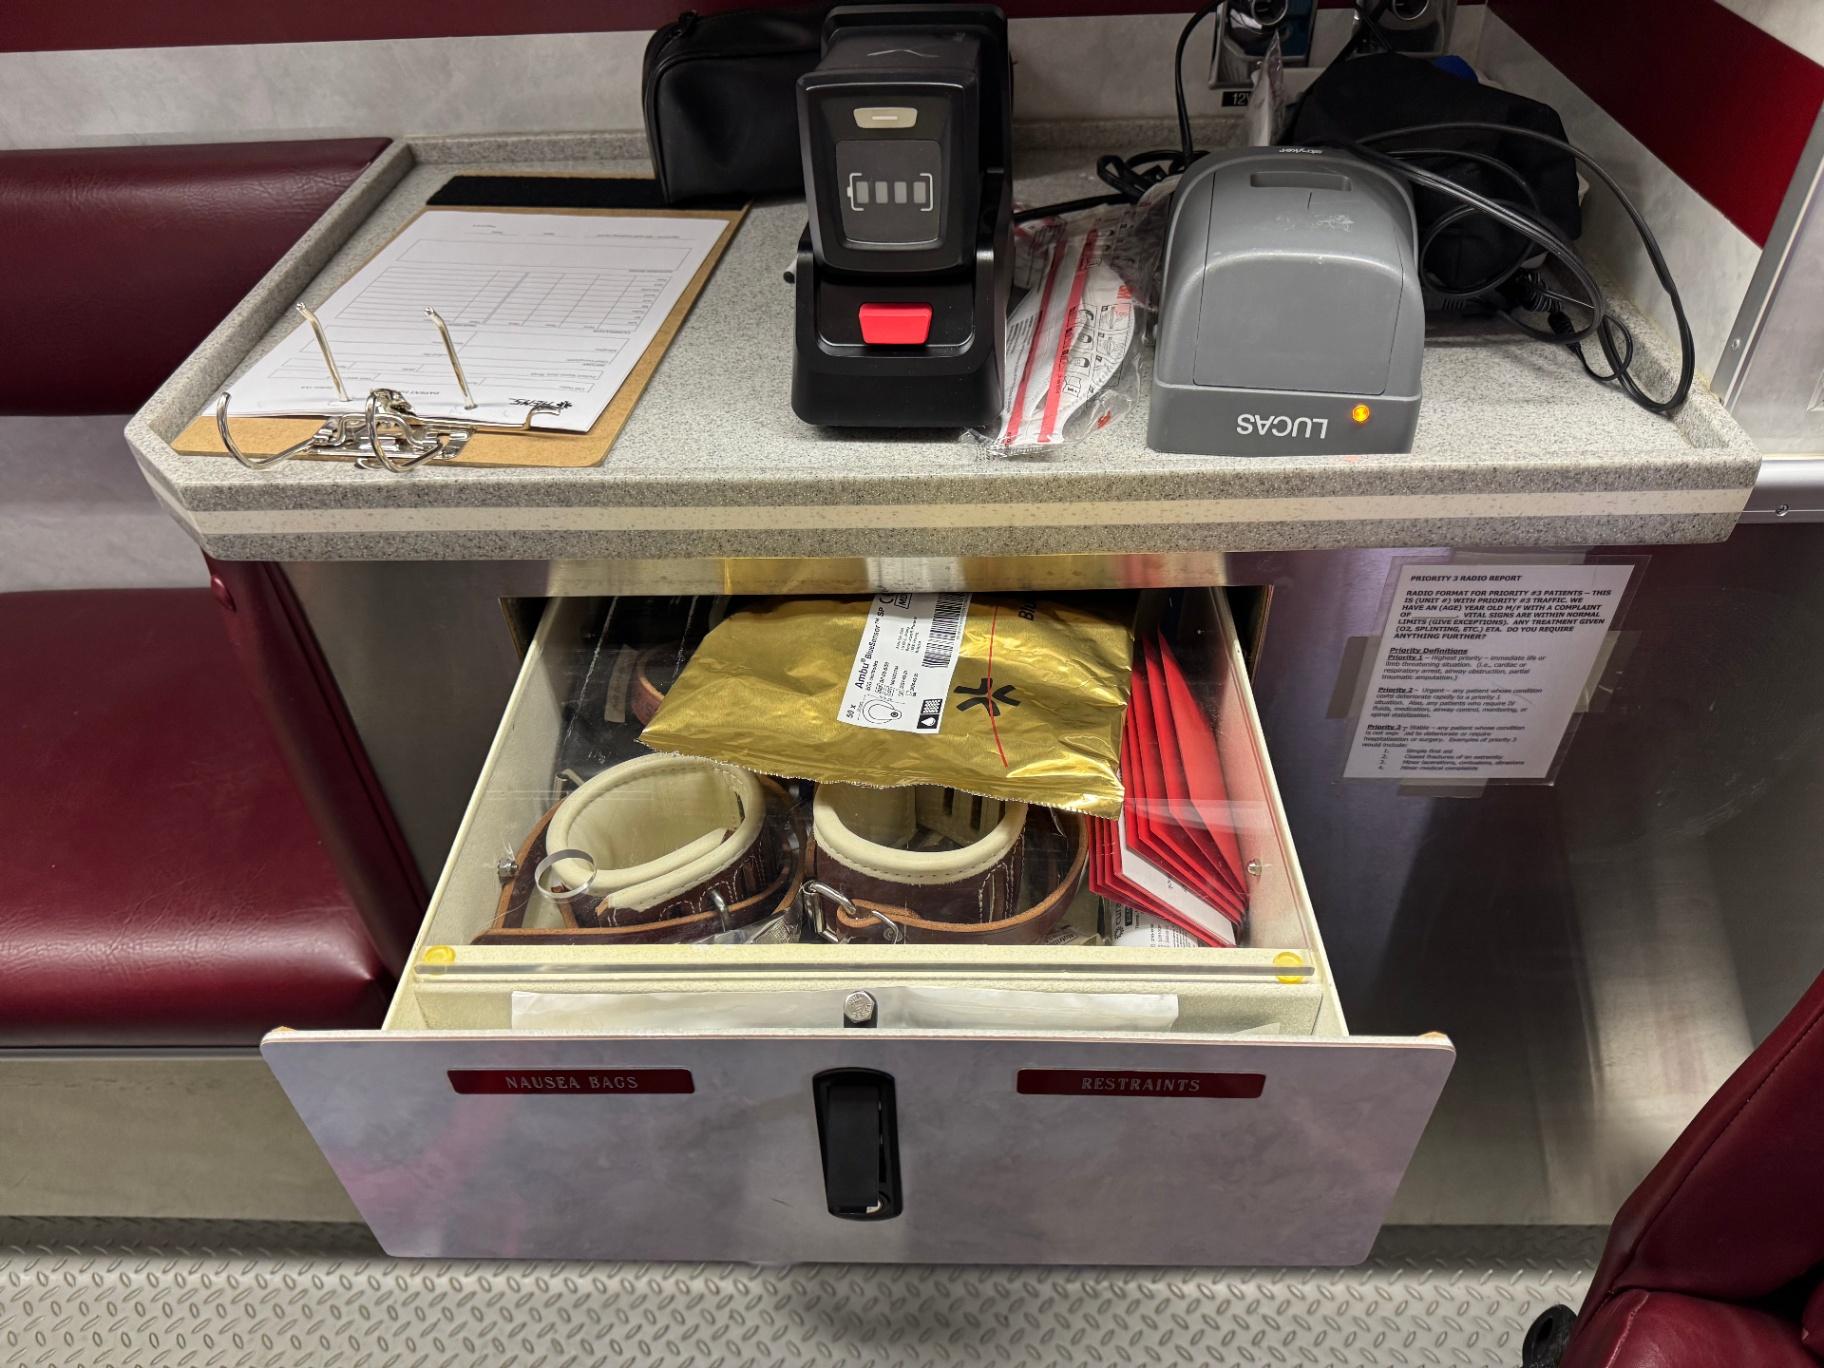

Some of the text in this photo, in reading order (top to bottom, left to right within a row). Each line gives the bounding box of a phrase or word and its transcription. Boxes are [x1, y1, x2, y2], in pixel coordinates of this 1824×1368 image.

[1279, 147, 1323, 155] stryker
[1237, 413, 1329, 440] LUCAS
[877, 606, 886, 619] SP
[846, 708, 855, 718] 50
[505, 1076, 639, 1090] NAUSEA BAGS
[1081, 1077, 1201, 1093] RESTRAINTS
